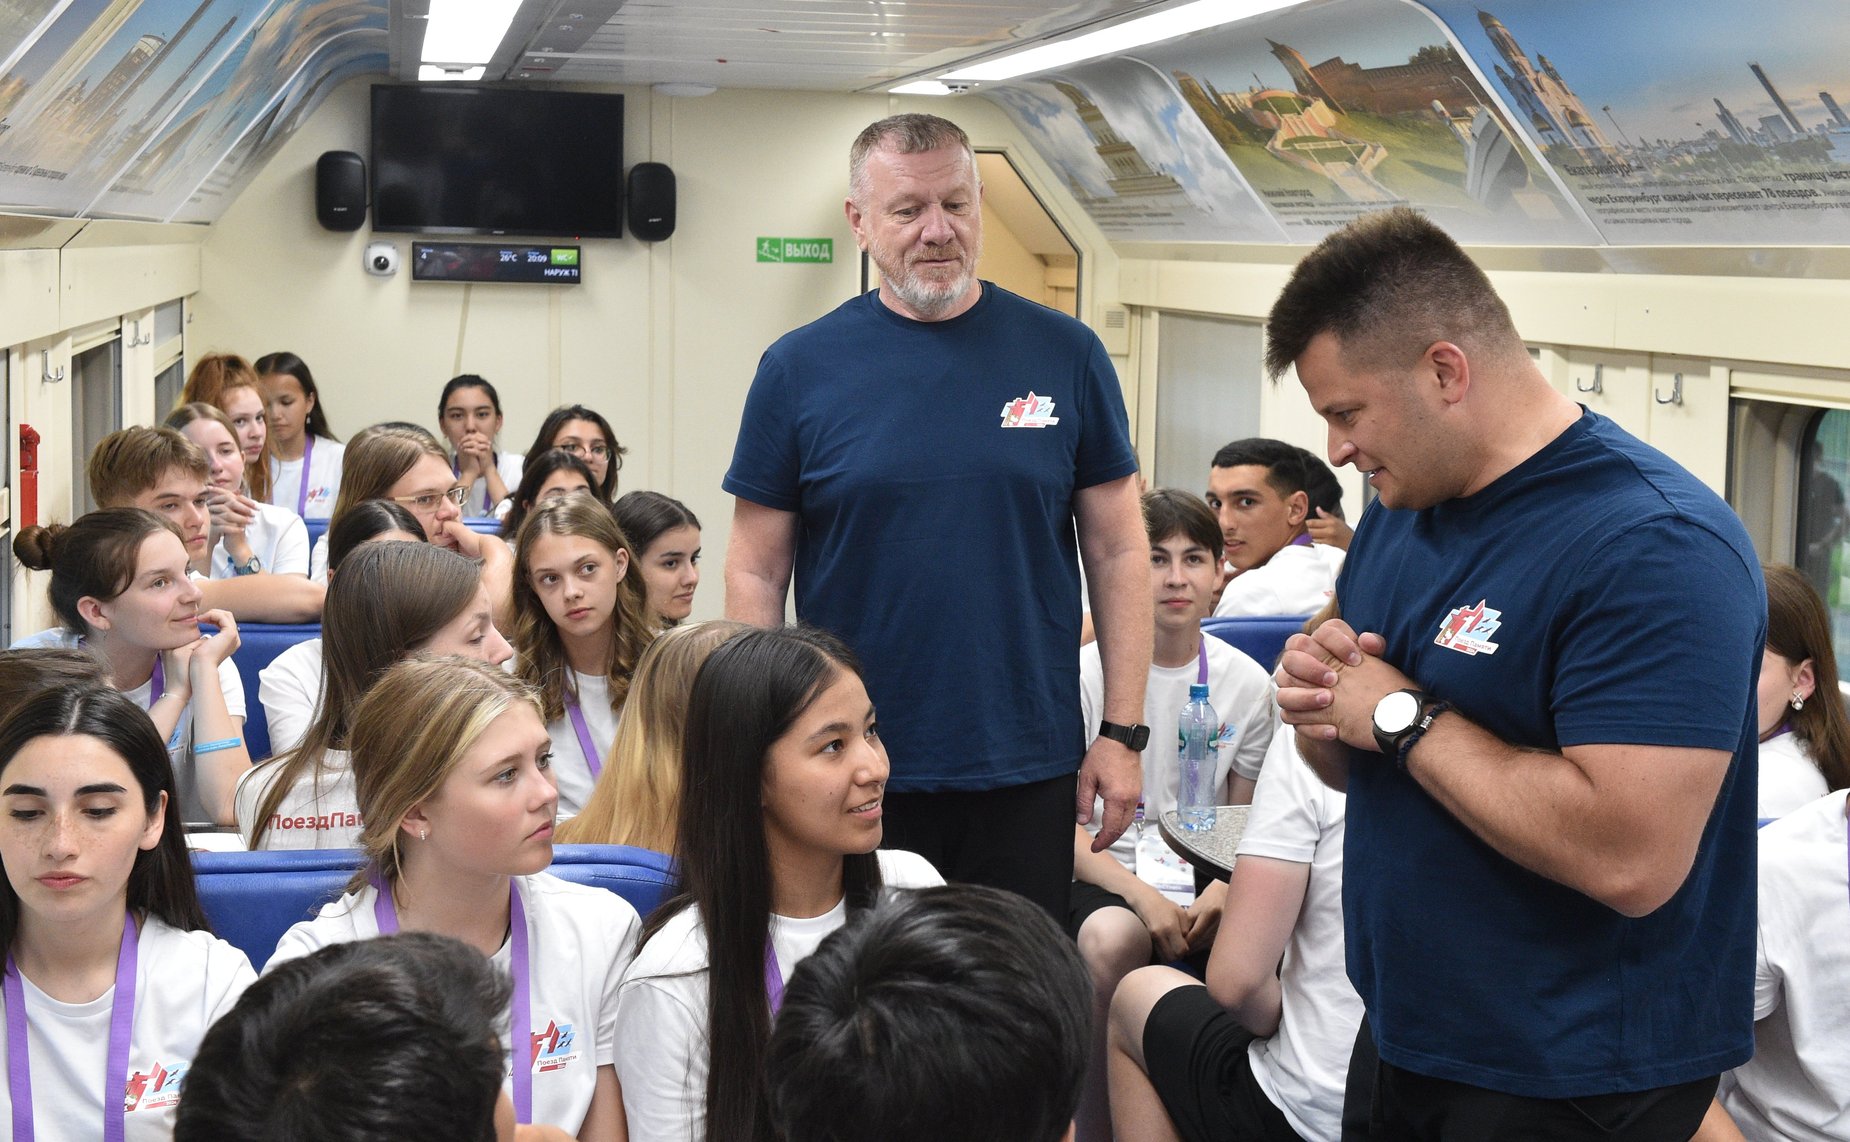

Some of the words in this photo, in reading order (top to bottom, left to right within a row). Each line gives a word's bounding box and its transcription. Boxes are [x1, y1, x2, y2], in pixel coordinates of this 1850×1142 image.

[1783, 171, 1828, 183] границу
[1710, 190, 1764, 202] пересекает
[1761, 187, 1777, 199] 78
[1775, 188, 1821, 200] поездов.
[785, 243, 830, 261] ВЫХОД
[527, 254, 548, 263] 20:09
[544, 268, 570, 277] НАРУЖ
